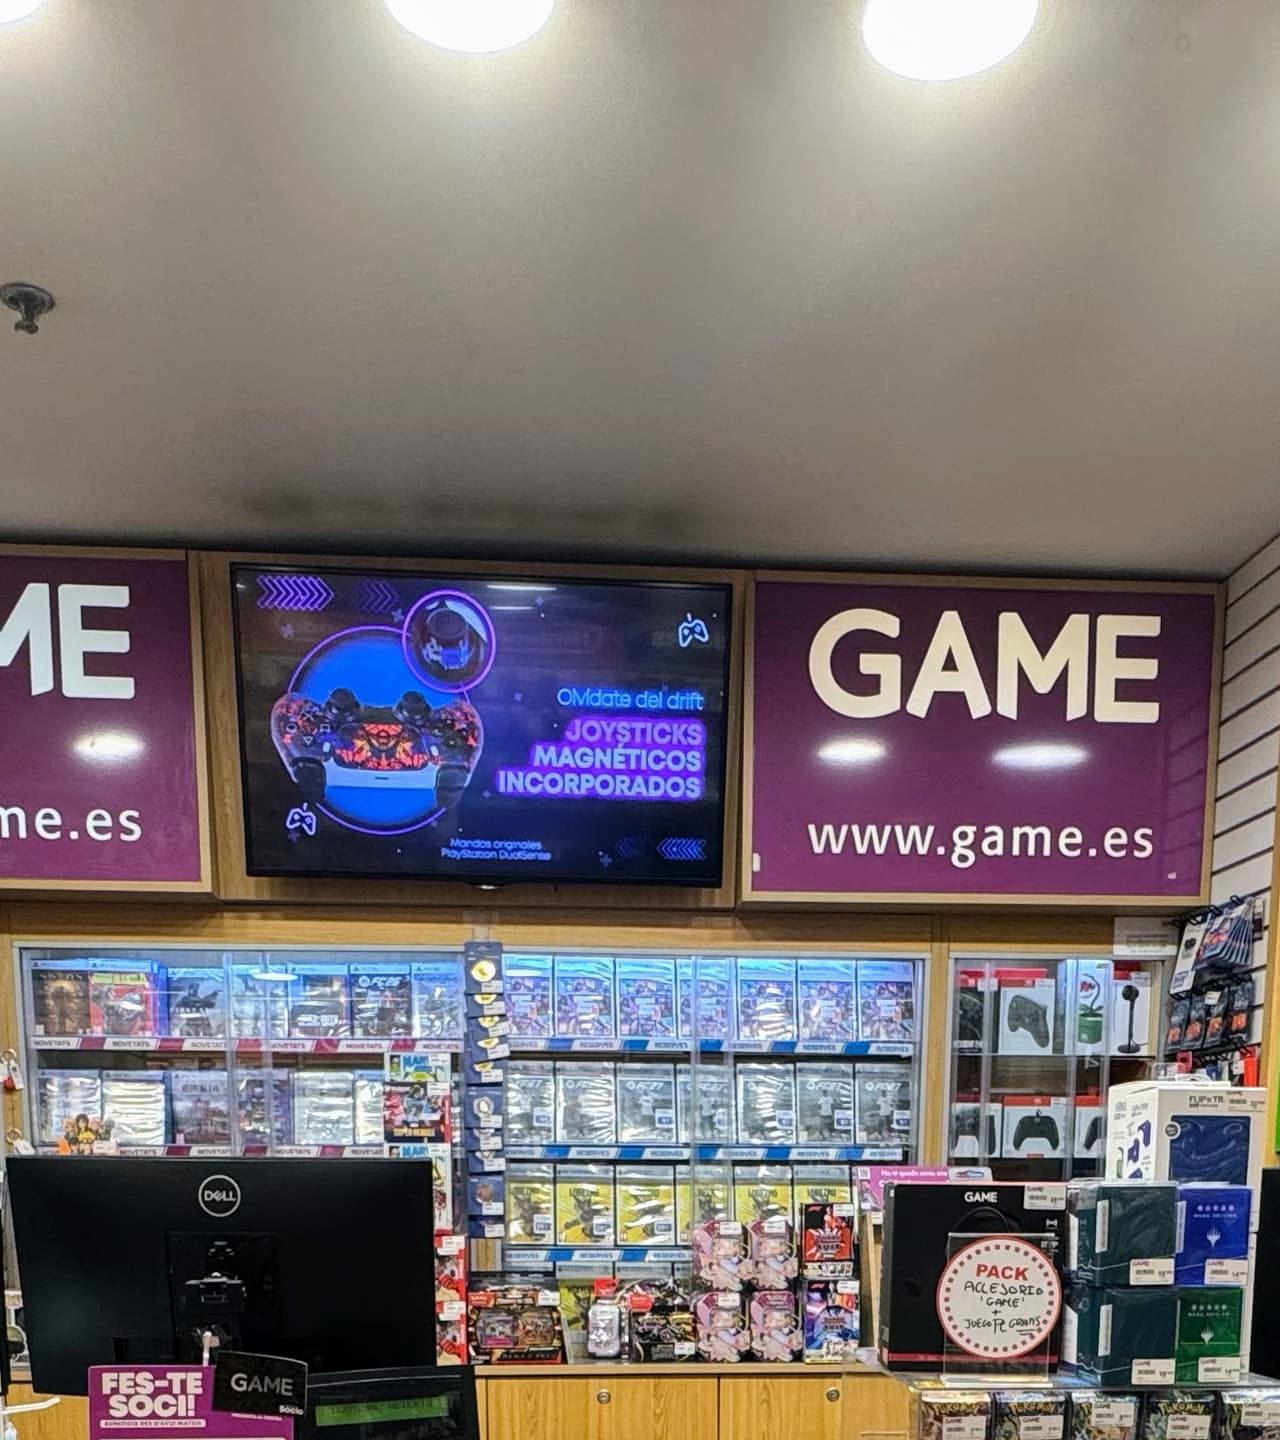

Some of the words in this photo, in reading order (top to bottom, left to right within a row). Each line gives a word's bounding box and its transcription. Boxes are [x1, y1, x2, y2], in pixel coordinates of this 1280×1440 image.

[808, 607, 1162, 725] GAME
[635, 689, 662, 708] del
[666, 690, 704, 711] drift
[566, 719, 703, 746] JOYSTICKS
[533, 741, 702, 772] MAGNÉTICOS
[498, 771, 702, 799] INCORPORADOS
[441, 848, 498, 861] PlayStation
[450, 837, 489, 851] Mandos
[493, 839, 543, 853] originales
[807, 822, 1154, 869] www.game.es
[205, 1189, 237, 1202] DELL
[964, 1191, 999, 1203] GAME
[975, 1263, 1030, 1282] PACK
[102, 1371, 203, 1395] FES-TE
[230, 1372, 294, 1397] GAME
[109, 1394, 196, 1418] SOCI!
